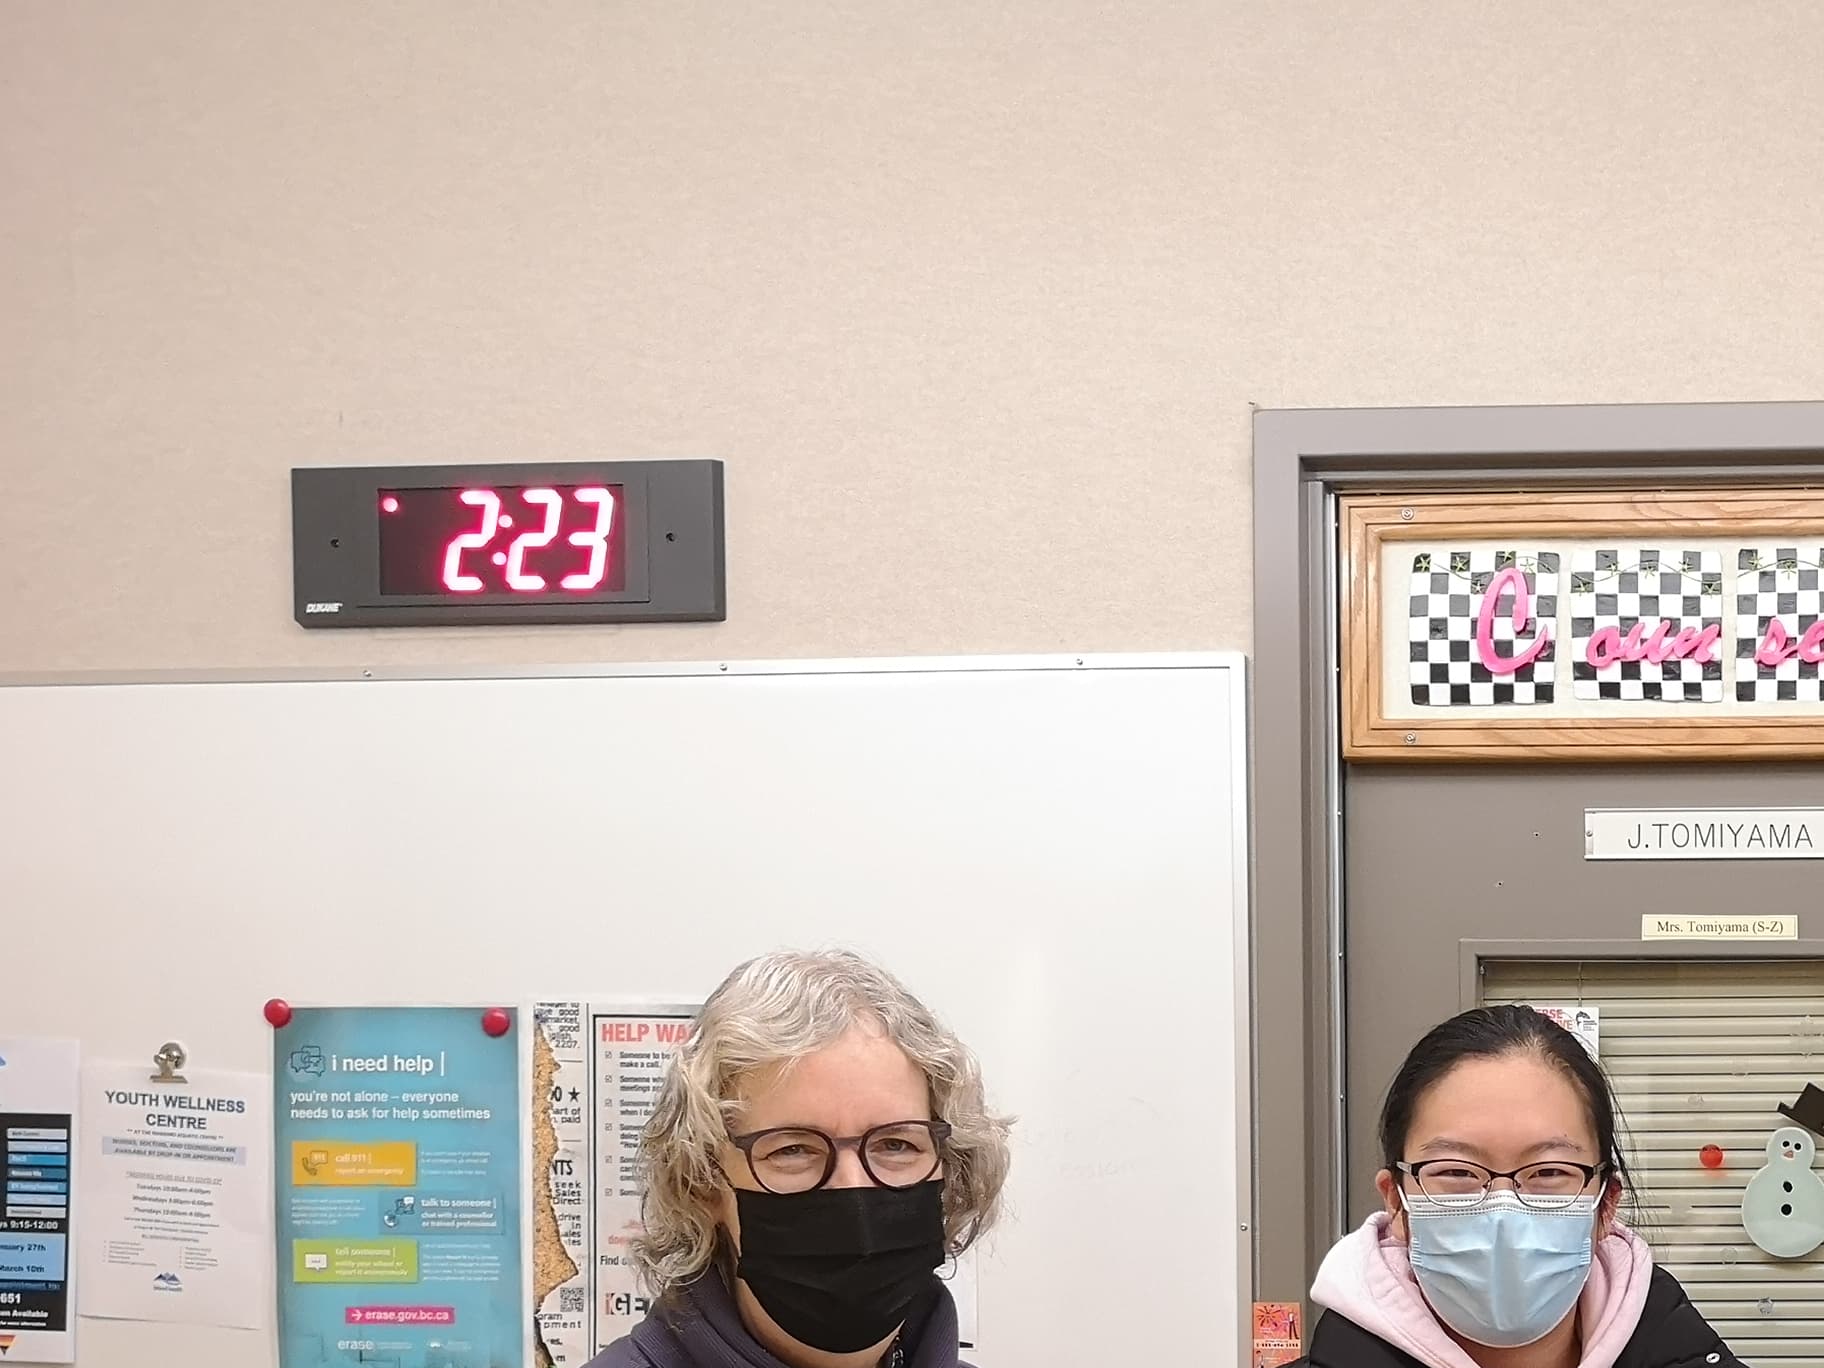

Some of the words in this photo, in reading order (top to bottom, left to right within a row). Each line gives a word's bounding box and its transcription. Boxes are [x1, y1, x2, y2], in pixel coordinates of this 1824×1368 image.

[442, 487, 615, 592] 2:23
[1627, 823, 1813, 849] J.TOMIYAMA
[1657, 921, 1683, 933] Mrs.
[1687, 920, 1749, 935] Tomiyama
[1752, 921, 1784, 935] (S-Z)
[602, 1023, 649, 1042] HELP
[332, 1054, 337, 1071] i
[342, 1054, 387, 1071] need
[393, 1054, 434, 1075] help
[105, 1090, 159, 1107] YOUTH
[163, 1094, 245, 1113] WELLNESS
[290, 1090, 328, 1104] you're
[331, 1091, 350, 1101] not
[354, 1091, 388, 1101] alone
[402, 1092, 459, 1104] everyone
[290, 1107, 328, 1119] needs
[331, 1109, 343, 1119] to
[347, 1108, 369, 1119] ask
[371, 1107, 388, 1119] for
[392, 1107, 420, 1121] help
[423, 1107, 491, 1120] sometimes
[146, 1114, 207, 1130] CENTRE
[555, 1181, 581, 1189] seek
[555, 1188, 581, 1197] Sales
[421, 1197, 438, 1207] talk
[440, 1199, 450, 1207] to
[451, 1199, 491, 1207] someone
[553, 1196, 581, 1205] Direct
[10, 1220, 58, 1229] 9:15-12:00
[27, 1243, 47, 1251] 27th
[600, 1255, 619, 1266] Find
[365, 1309, 449, 1322] erase.gov.bc.ca
[337, 1339, 374, 1350] erase
